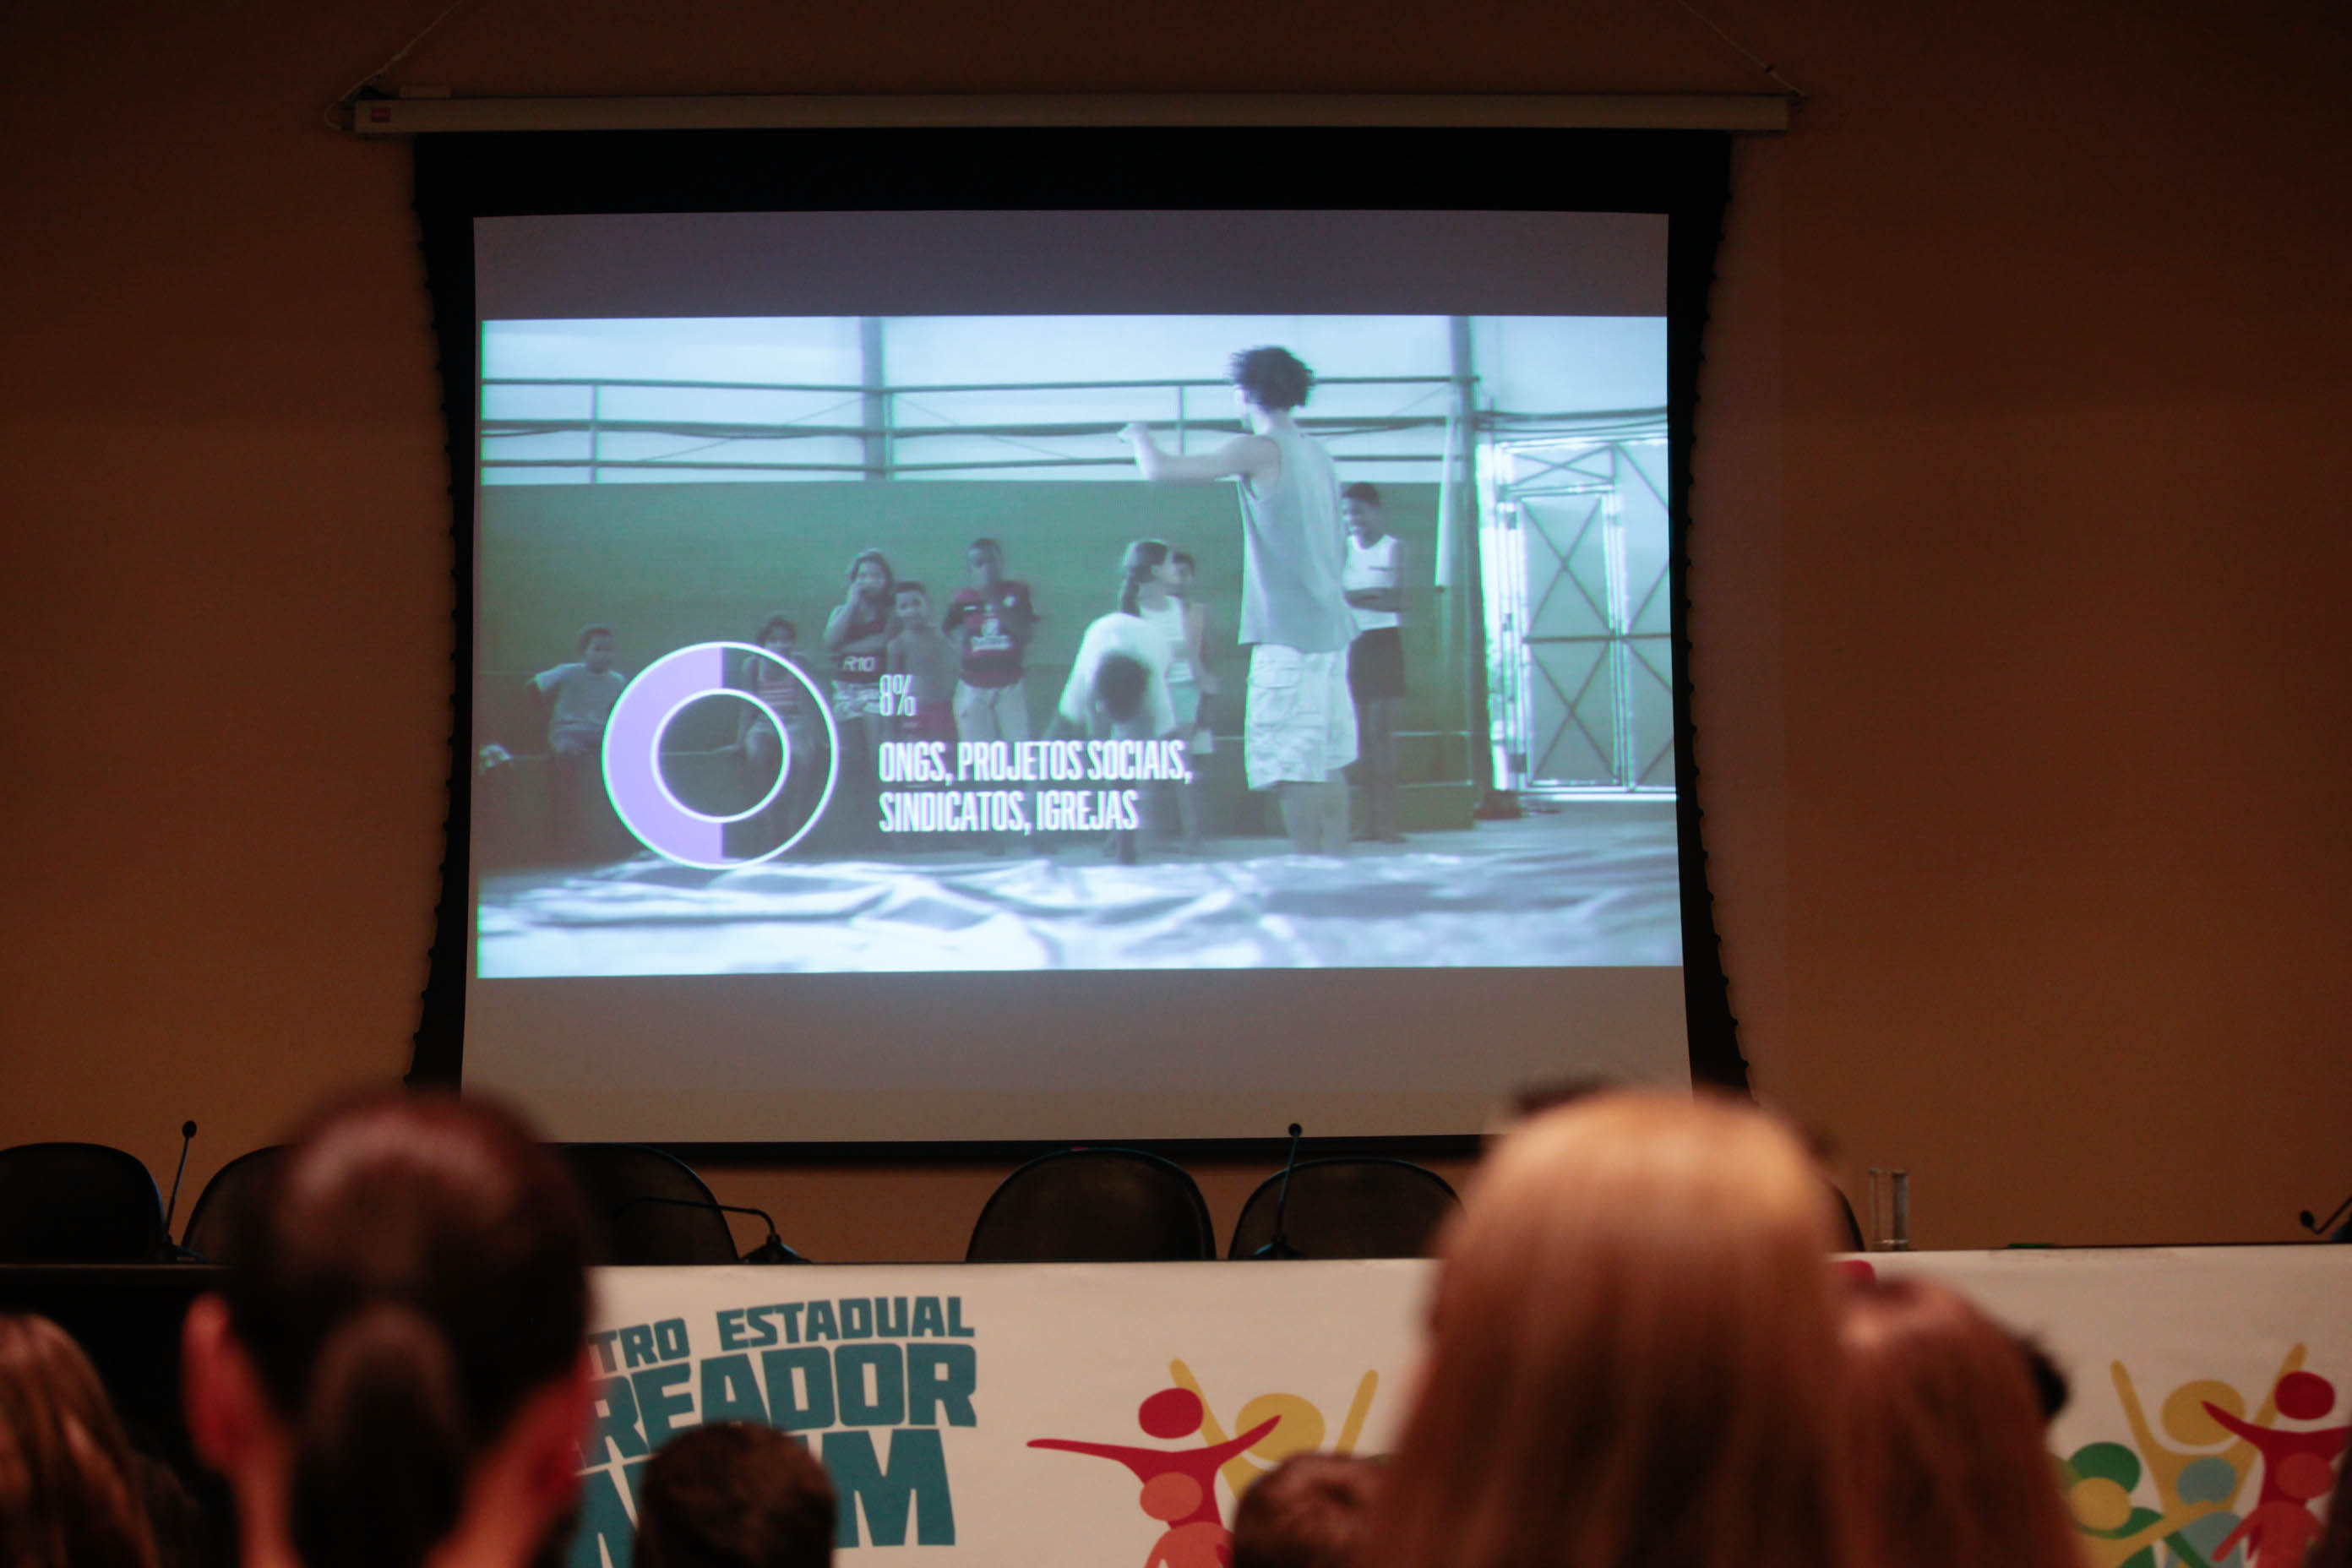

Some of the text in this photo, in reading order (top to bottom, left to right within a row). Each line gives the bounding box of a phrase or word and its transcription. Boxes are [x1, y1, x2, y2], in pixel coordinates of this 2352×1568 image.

[879, 674, 917, 716] 8%
[879, 739, 1193, 786] ONGS, PROJETOS SOCIAIS,
[879, 790, 1140, 836] SINDICATOS, IGREJAS
[586, 1296, 976, 1375] TRO ESTADUAL
[578, 1342, 977, 1470] READOR
